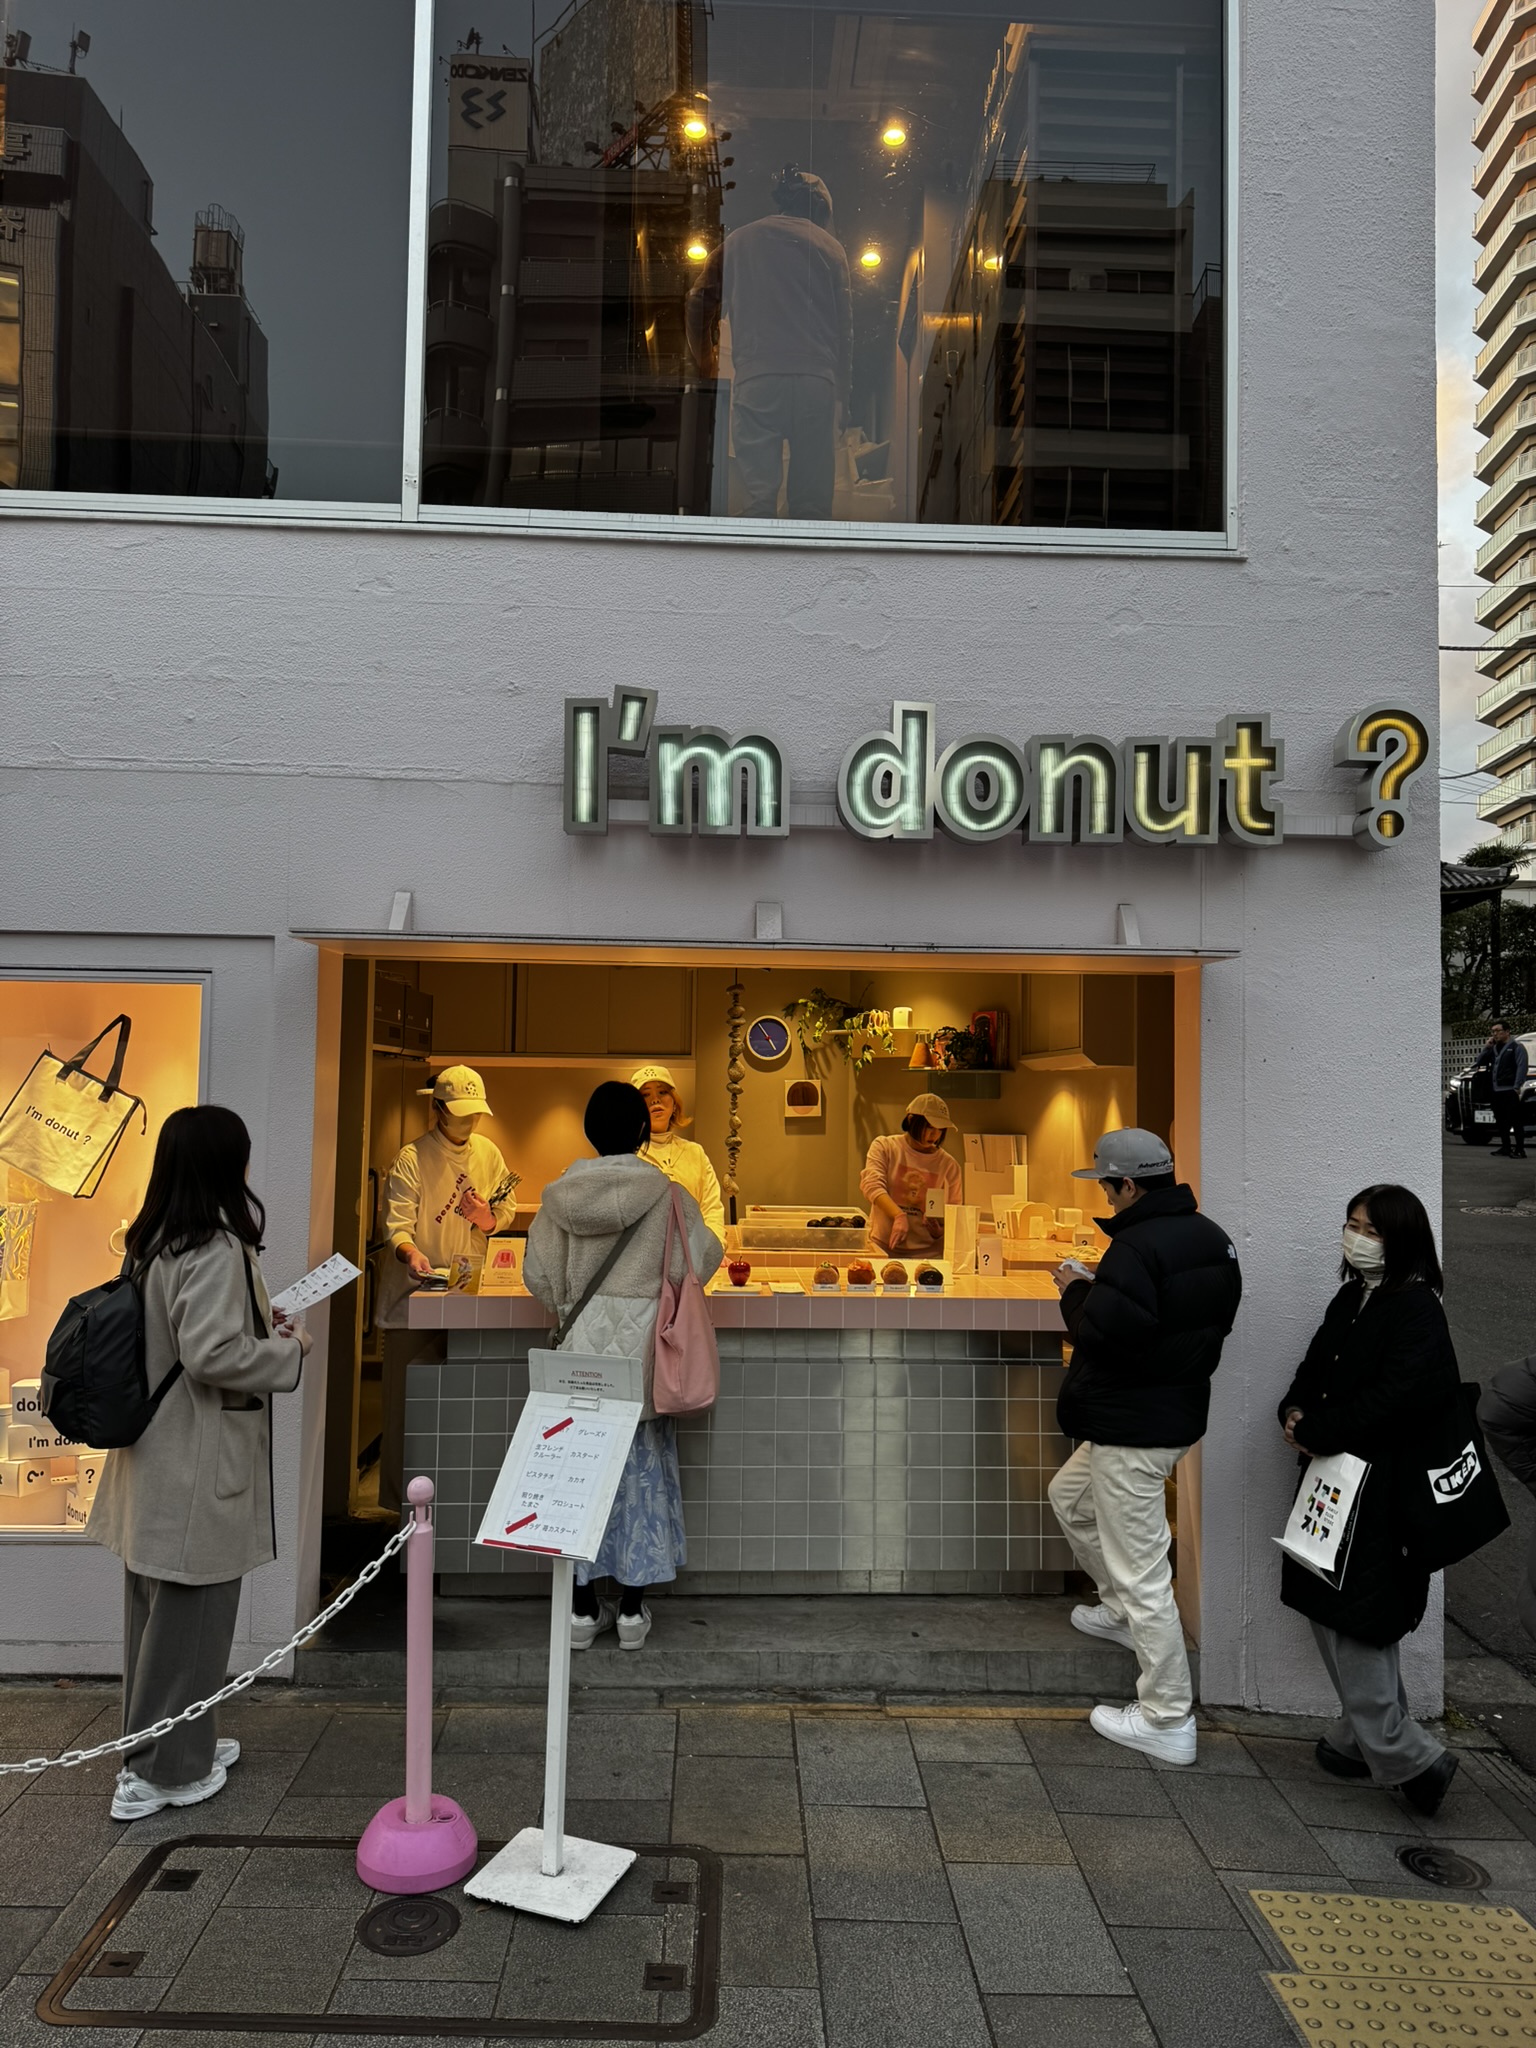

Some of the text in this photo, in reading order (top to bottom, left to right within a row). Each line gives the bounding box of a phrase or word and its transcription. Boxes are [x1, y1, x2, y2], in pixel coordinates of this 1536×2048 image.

[564, 685, 1429, 851] I'm donut ?
[25, 1105, 92, 1145] I'm donut ?
[435, 1192, 457, 1224] peace
[928, 1200, 935, 1209] ?
[983, 1254, 990, 1266] ?
[571, 1370, 603, 1379] ATTENTION
[578, 1428, 607, 1438] グレーズド
[28, 1436, 49, 1449] I'm
[535, 1443, 564, 1453] 生フレンチ
[533, 1451, 562, 1460] クルーラー
[569, 1451, 600, 1460] カスタード
[85, 1468, 95, 1484] ?
[525, 1470, 555, 1481] ピスタチオ
[1438, 1455, 1476, 1492] IKEA
[567, 1475, 586, 1485] カカオ
[552, 1498, 586, 1510] プロシュート
[67, 1504, 87, 1525] donut
